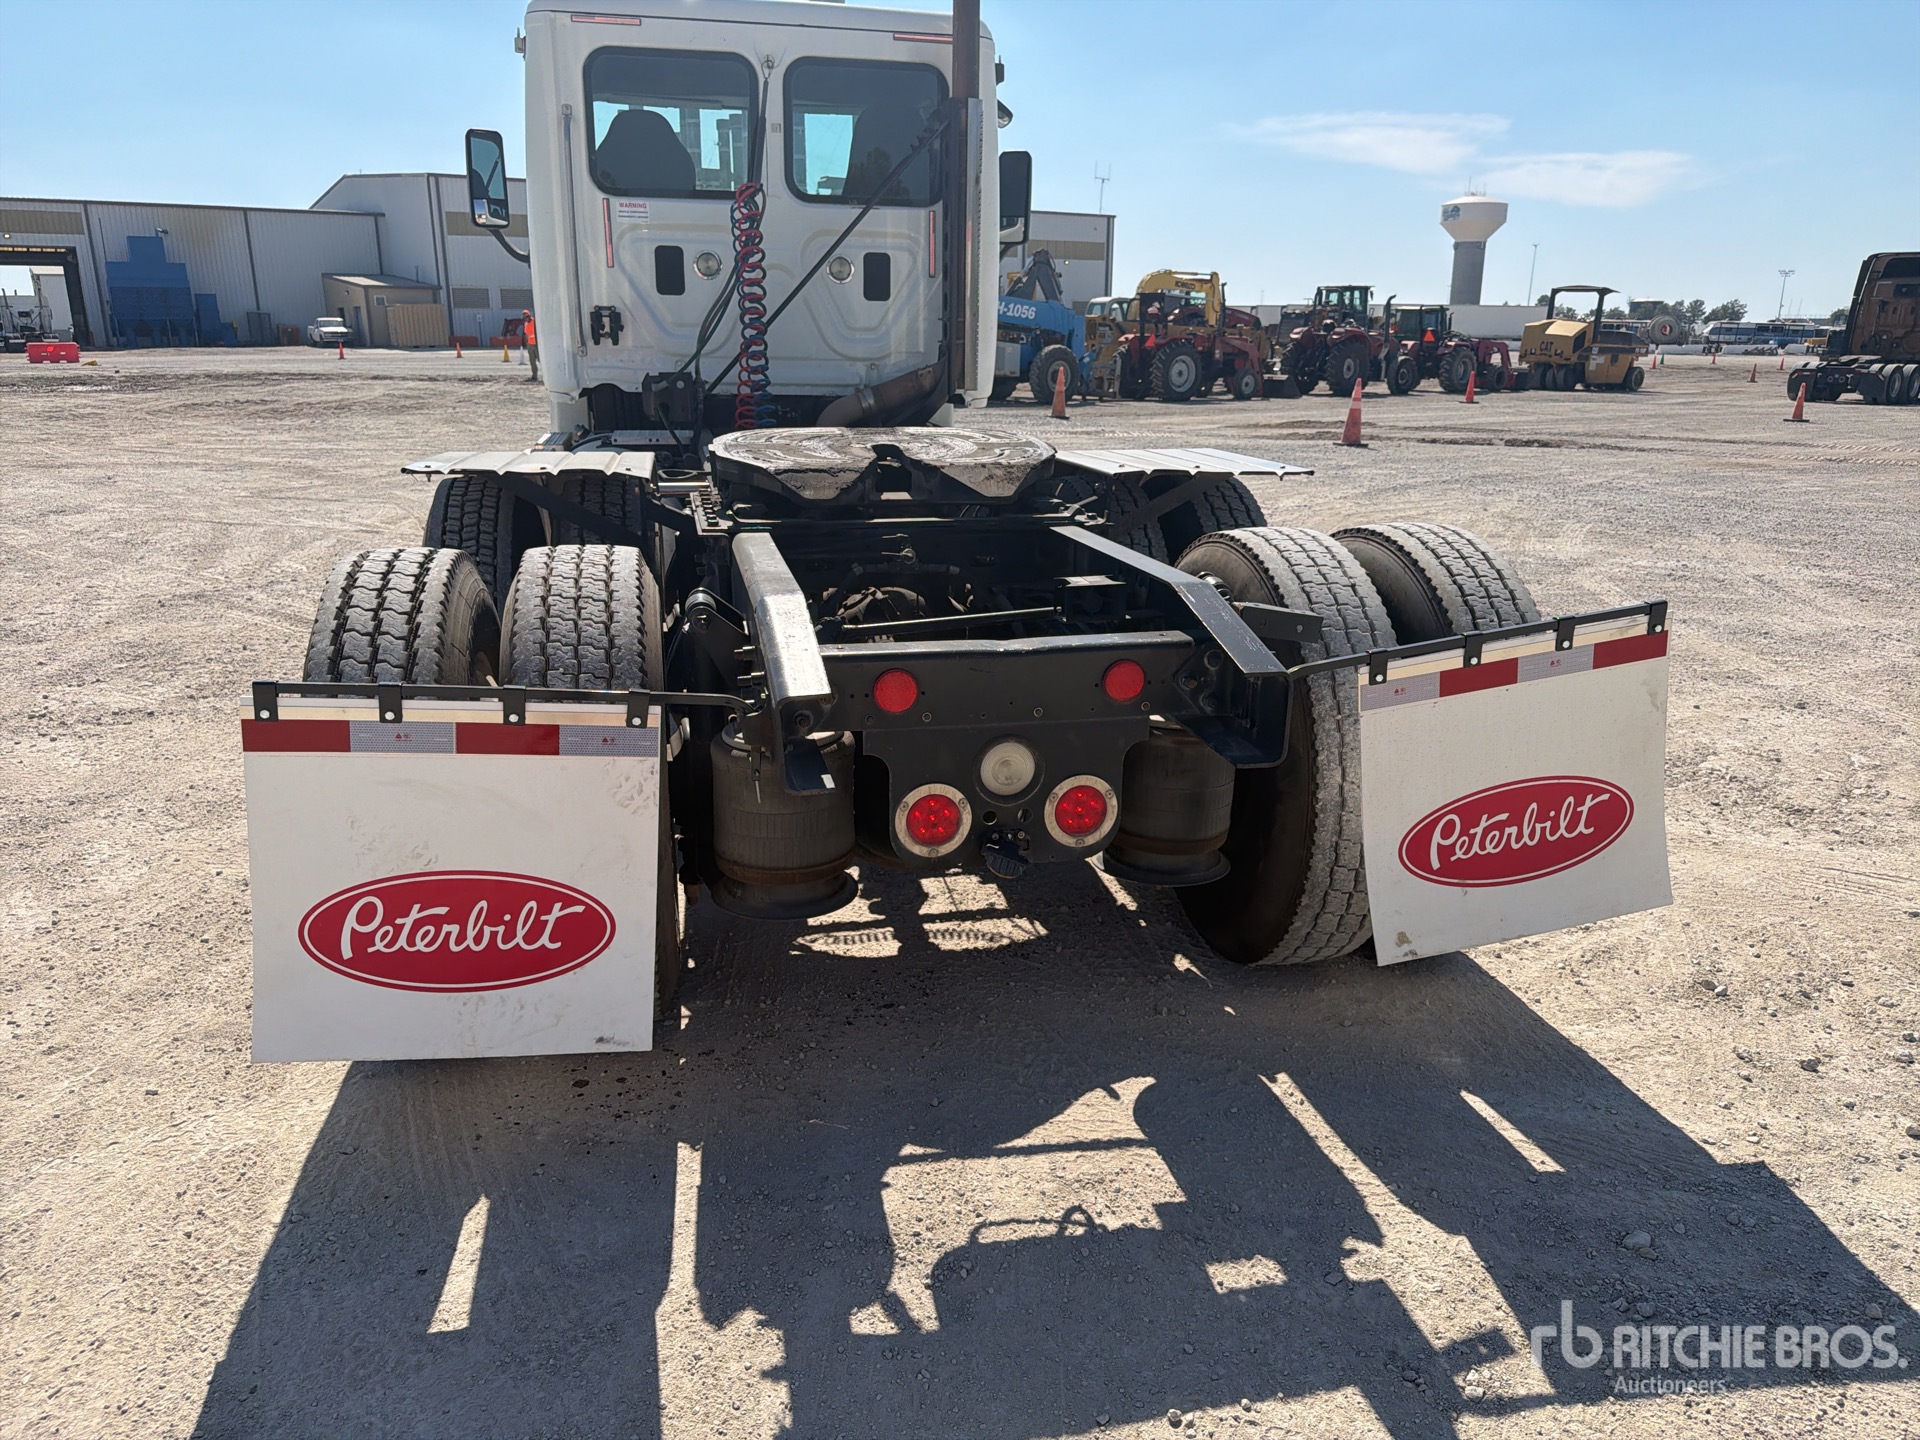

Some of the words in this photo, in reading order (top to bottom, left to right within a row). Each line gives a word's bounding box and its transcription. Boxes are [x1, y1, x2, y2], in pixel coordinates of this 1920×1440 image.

[1540, 341, 1554, 353] CAT
[1430, 793, 1611, 871] Peterbilt
[340, 895, 586, 961] Peterbilt
